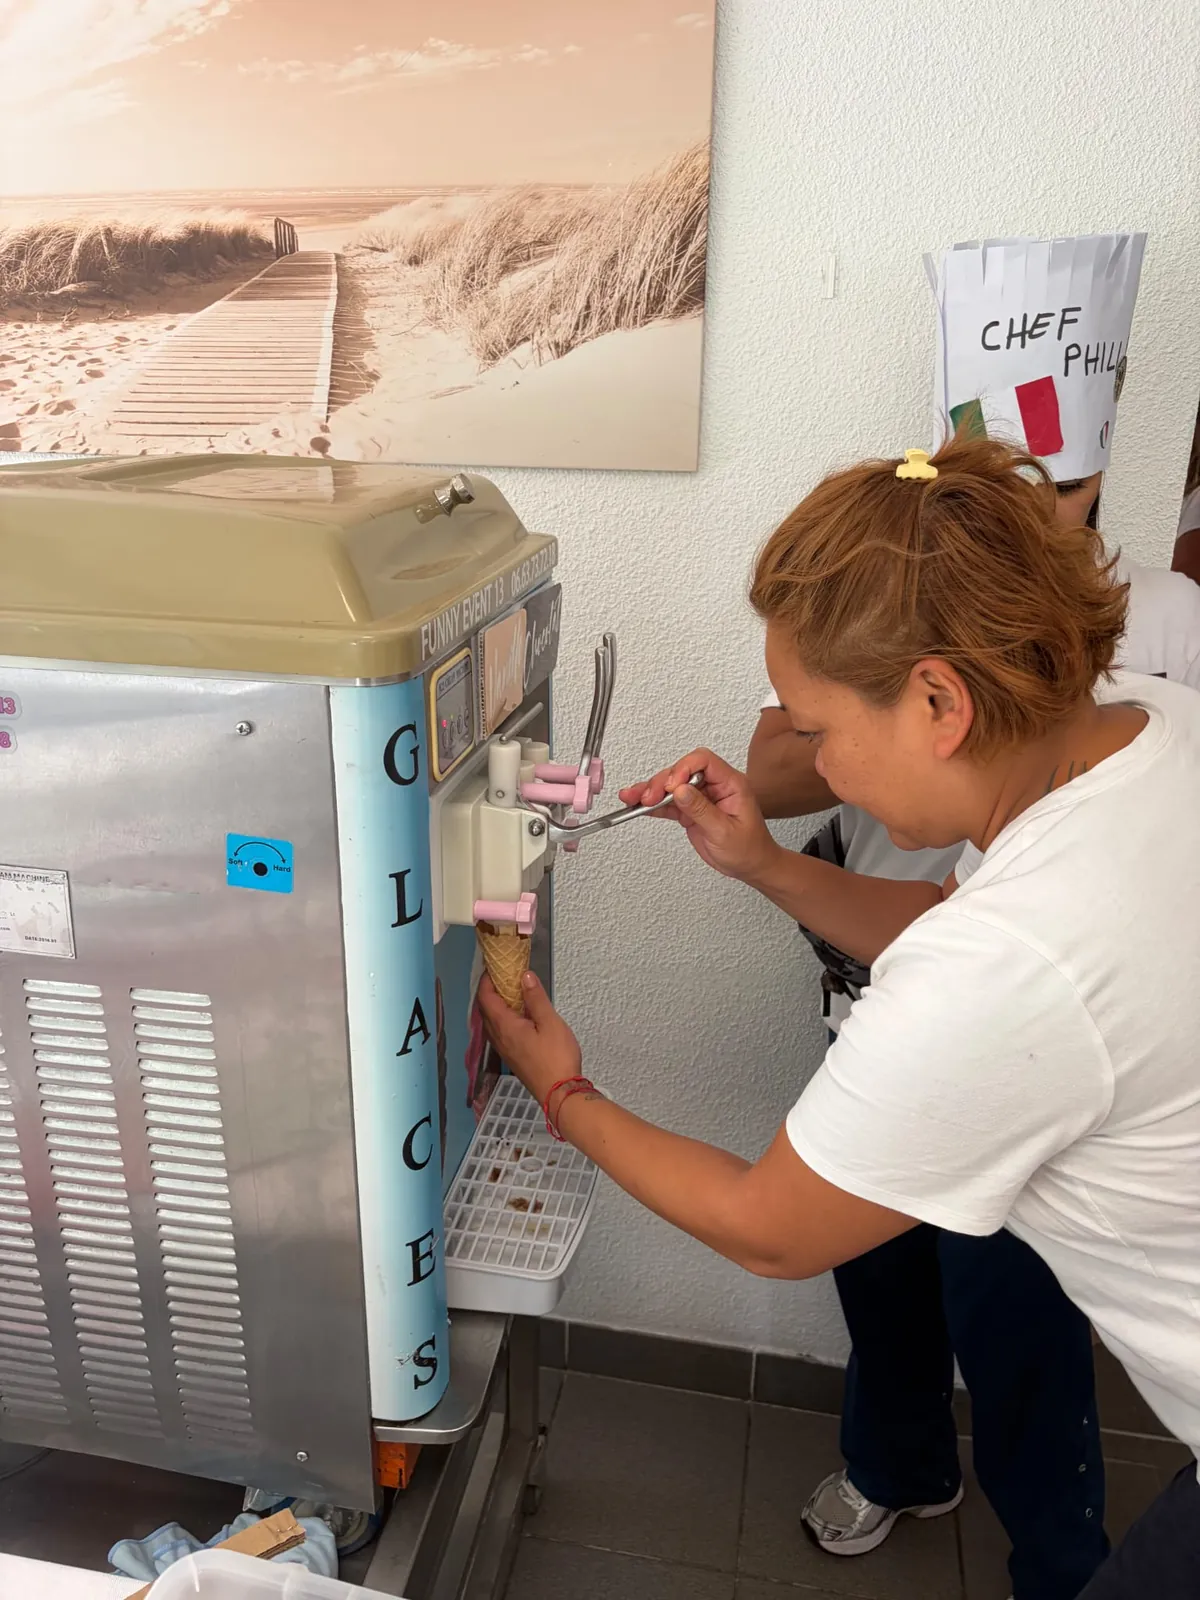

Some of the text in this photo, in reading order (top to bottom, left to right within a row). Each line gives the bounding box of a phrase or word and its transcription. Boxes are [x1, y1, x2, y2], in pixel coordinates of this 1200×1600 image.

[981, 306, 1082, 351] CHEF
[421, 603, 460, 661] FUNNY
[462, 583, 492, 631] EVENT
[494, 576, 504, 607] 13
[273, 864, 292, 873] Hard
[383, 720, 438, 1390] GLACES
